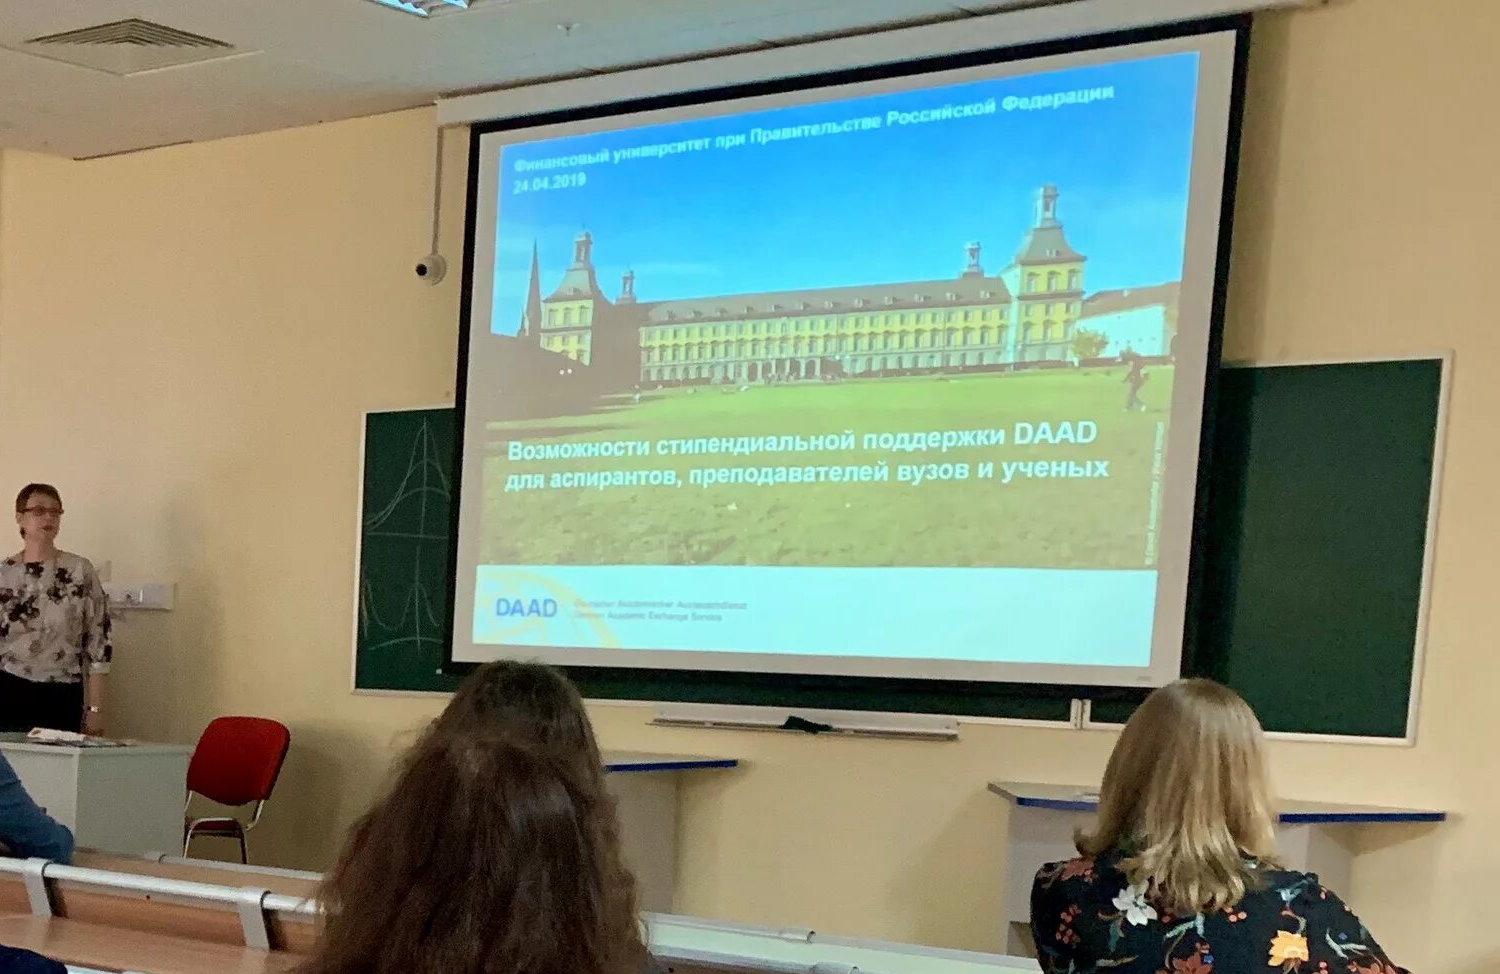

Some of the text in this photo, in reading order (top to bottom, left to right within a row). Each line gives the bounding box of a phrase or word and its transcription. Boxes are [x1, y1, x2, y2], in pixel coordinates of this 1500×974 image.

[514, 85, 1115, 172] Финансовый университет при Правительстве Российской Федерации
[513, 171, 587, 195] 24.04.2019
[507, 420, 1098, 461] Возможности стипендиальной поддержки DAAD
[504, 460, 1110, 492] для аспирантов, преподавателей вузов и ученых
[495, 598, 558, 618] DAAD
